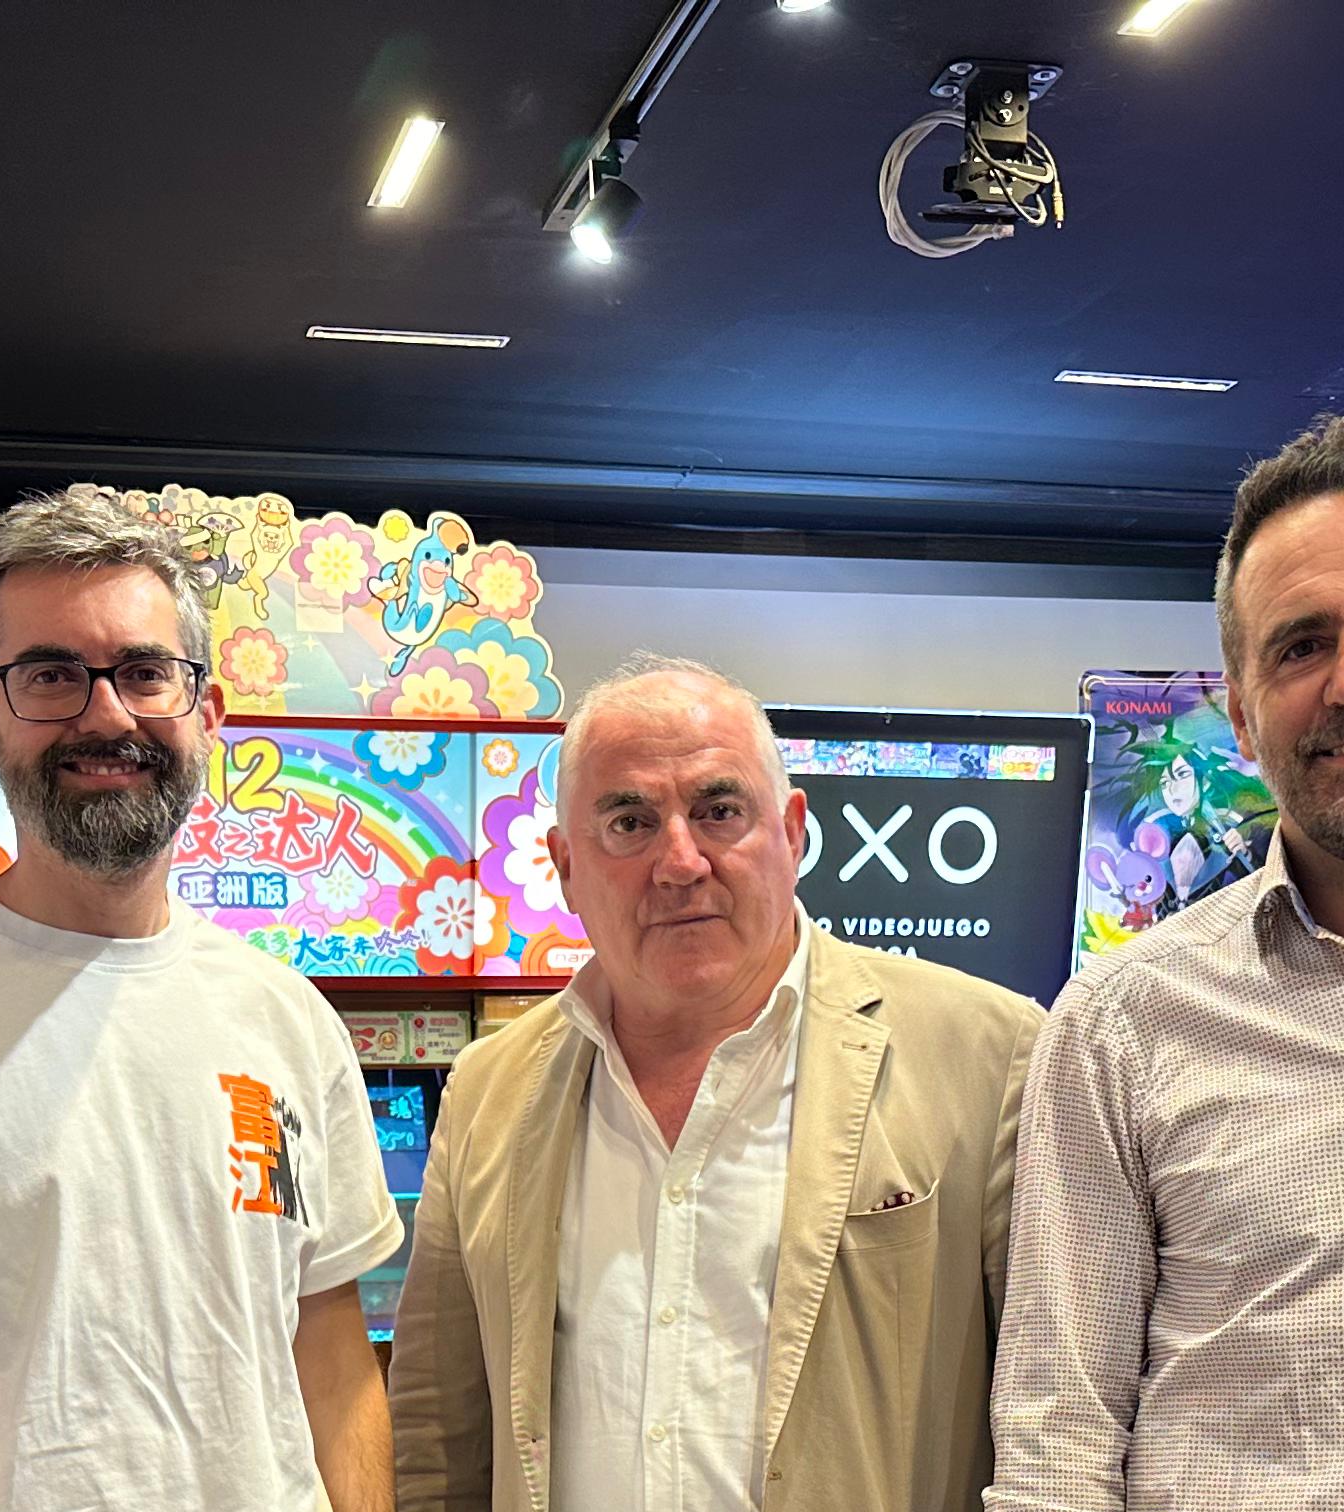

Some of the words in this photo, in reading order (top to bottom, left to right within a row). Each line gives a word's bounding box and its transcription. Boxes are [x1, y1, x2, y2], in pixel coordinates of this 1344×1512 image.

[1105, 699, 1172, 715] KONAMI
[180, 873, 287, 907] 亚洲版
[842, 917, 992, 938] VIDEOJUEGO
